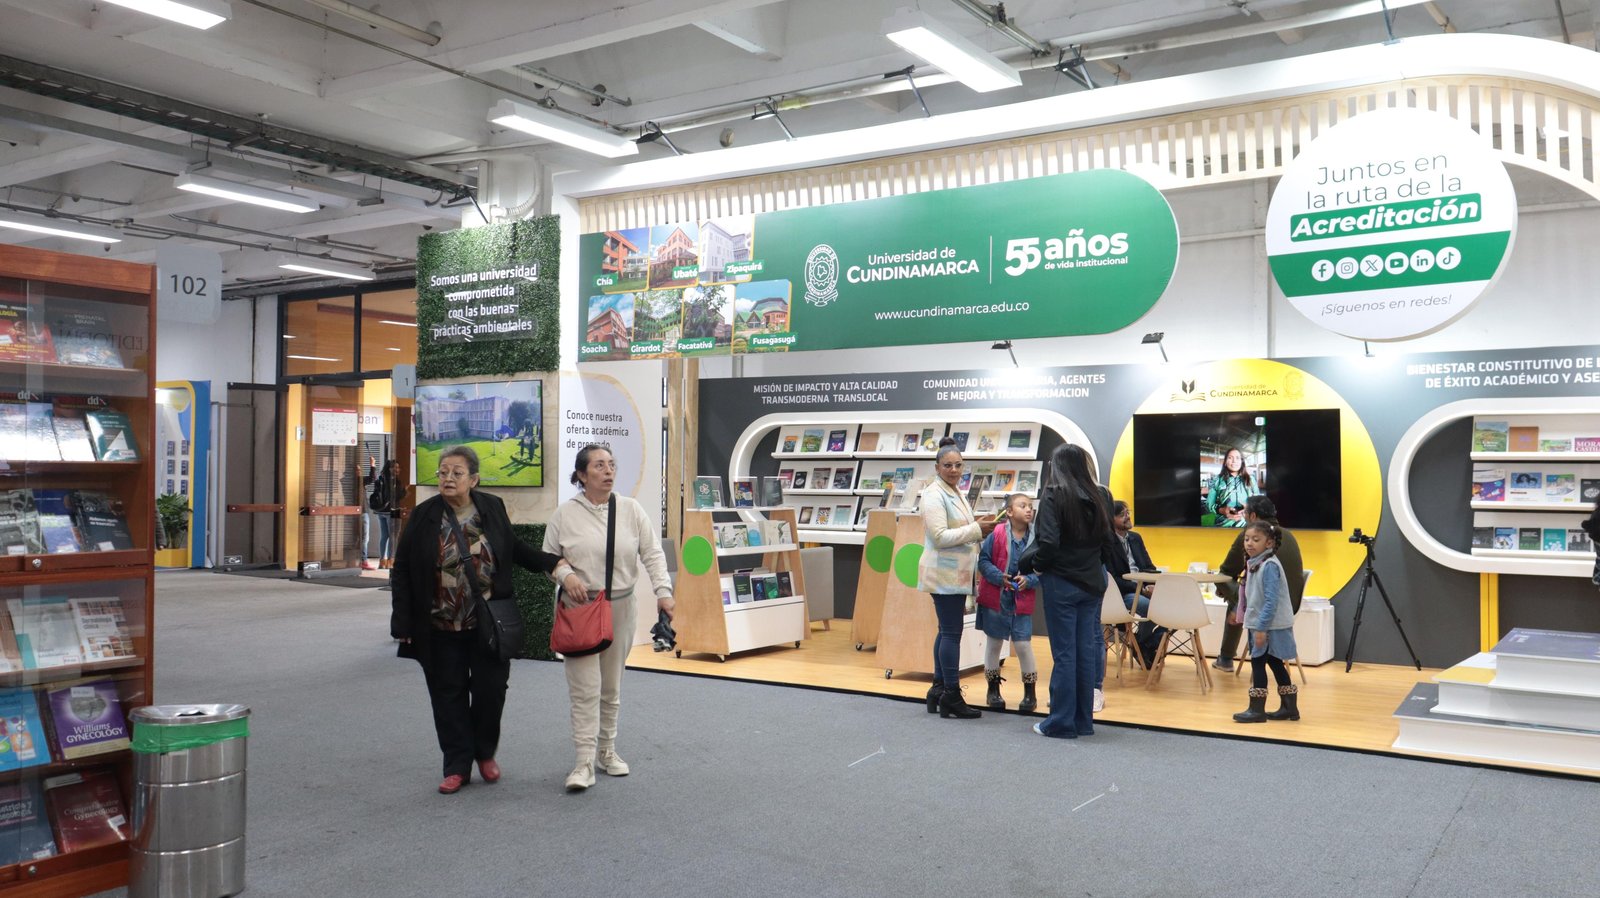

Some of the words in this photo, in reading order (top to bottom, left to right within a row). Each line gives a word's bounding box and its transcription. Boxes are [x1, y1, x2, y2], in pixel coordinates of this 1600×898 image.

[1316, 160, 1406, 185] Juntos
[1414, 154, 1448, 172] en
[1307, 191, 1326, 210] la
[1336, 185, 1388, 206] ruta
[1397, 178, 1431, 198] de
[1441, 173, 1462, 192] la
[1291, 199, 1479, 237] Acreditación
[868, 247, 938, 265] Universidad
[940, 246, 956, 258] de
[1004, 237, 1042, 276] 55
[1044, 228, 1129, 260] años
[726, 262, 763, 274] Zipaquirá
[847, 259, 980, 283] CUNDINAMARCA
[1044, 262, 1056, 270] de
[1056, 260, 1075, 269] vida
[1076, 256, 1128, 267] institucional
[431, 275, 459, 287] Somos
[461, 272, 478, 284] una
[480, 263, 537, 281] universidad
[596, 276, 613, 286] Chía
[673, 267, 698, 279] Ubaté
[170, 274, 207, 296] 102
[448, 284, 514, 303] comprometida
[448, 309, 463, 319] con
[465, 305, 478, 317] las
[480, 302, 515, 316] buenas
[874, 301, 1030, 320] www.ucundinamarca.edu.co
[1321, 299, 1386, 316] ¡Síguenos
[1389, 300, 1406, 309] en
[1410, 294, 1452, 308] redes!
[433, 324, 471, 340] prácticas
[473, 319, 533, 334] ambientales
[630, 343, 661, 353] Girardot
[678, 340, 713, 350] Facatativá
[752, 335, 796, 346] Fusagasugá
[581, 345, 608, 354] Soacha
[1406, 362, 1475, 375] BIENESTAR
[1479, 357, 1573, 372] CONSTITUTIVO
[1575, 357, 1593, 368] DE
[753, 382, 782, 393] MISIÓN
[783, 383, 794, 392] DE
[795, 382, 831, 392] IMPACTO
[832, 382, 838, 391] Y
[839, 381, 860, 390] ALTA
[861, 380, 898, 390] CALIDAD
[923, 377, 978, 389] COMUNIDAD
[1059, 373, 1106, 385] AGENTES
[1425, 377, 1441, 388] DE
[1444, 374, 1481, 388] ÉXITO
[1483, 372, 1559, 387] ACADÉMICO
[1561, 372, 1572, 384] Y
[761, 394, 830, 404] TRANSMODERNA
[833, 393, 889, 403] TRANSLOCAL
[936, 390, 949, 401] DE
[950, 389, 987, 402] MEJORA
[988, 390, 996, 400] Y
[1209, 389, 1278, 398] CUNDINAMARCA
[566, 409, 594, 421] Conoce
[595, 413, 623, 422] nuestra
[566, 424, 590, 435] oferta
[591, 426, 629, 437] académica
[566, 439, 576, 449] de
[66, 727, 123, 743] GYNECOLOGY
[73, 723, 111, 734] Williams
